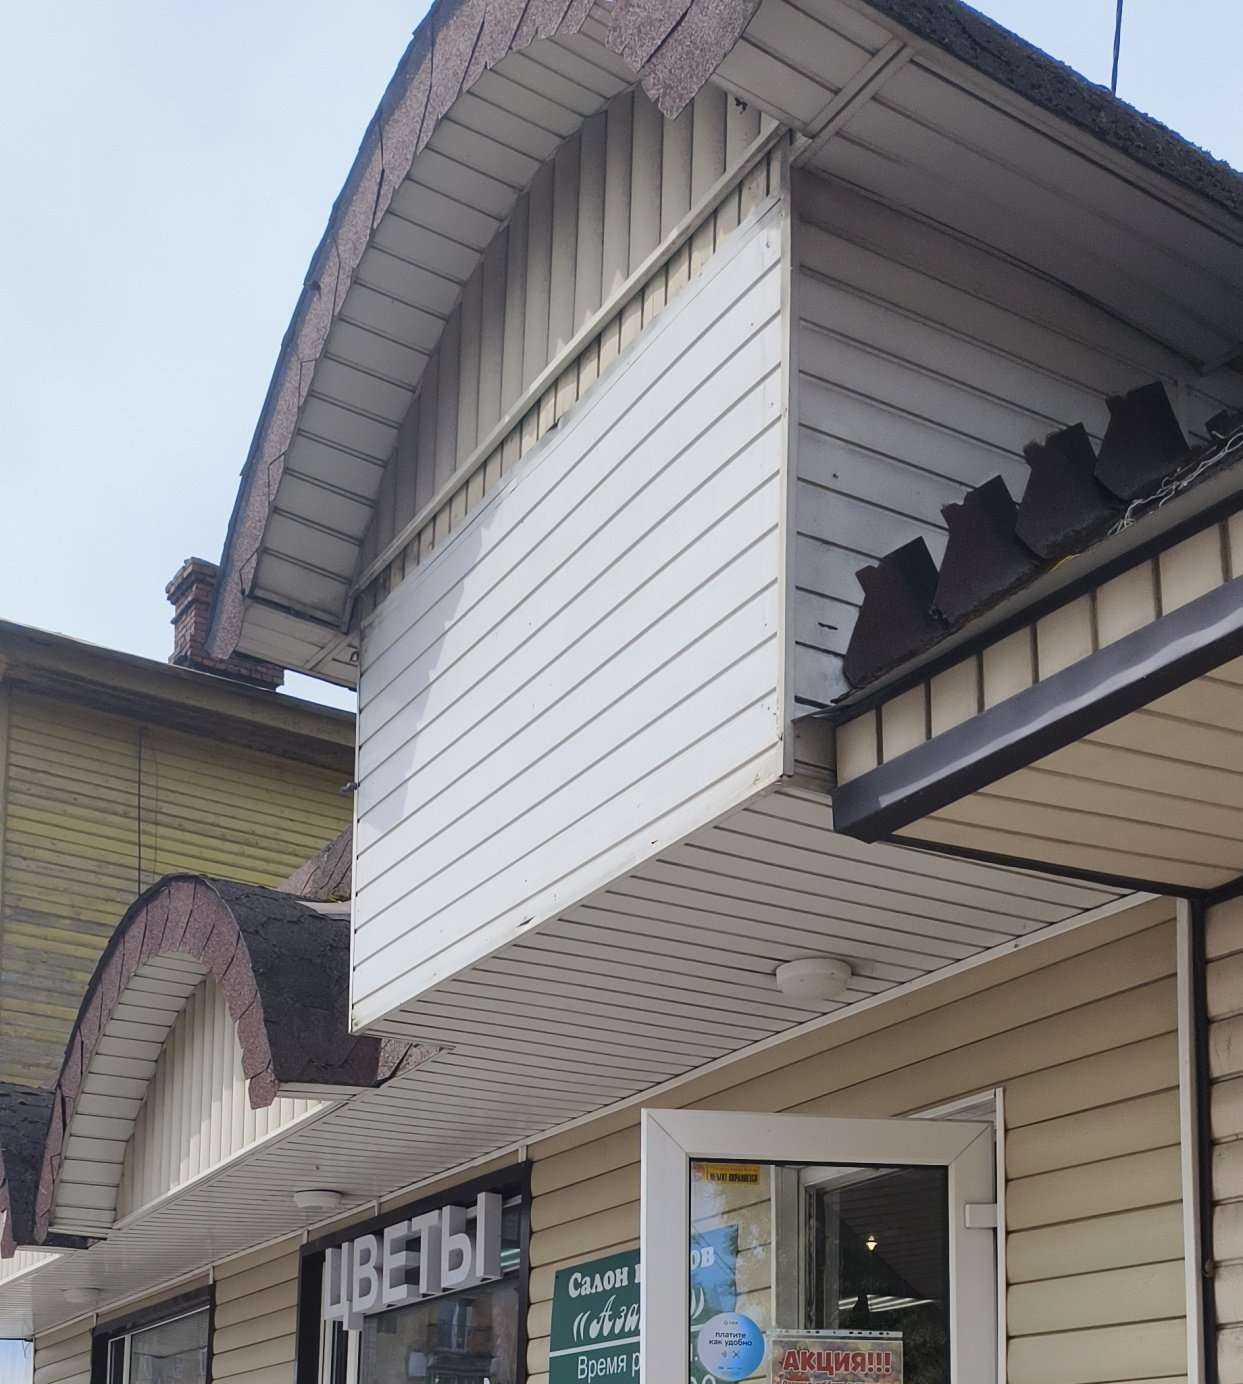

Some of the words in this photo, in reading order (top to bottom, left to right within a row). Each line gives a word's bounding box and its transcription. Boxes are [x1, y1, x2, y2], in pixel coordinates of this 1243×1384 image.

[324, 1192, 502, 1330] ЦВЕТЫ
[568, 1266, 629, 1298] Салон
[715, 1331, 747, 1339] платите
[724, 1338, 753, 1347] удобно
[577, 1352, 627, 1384] Время
[782, 1350, 892, 1376] АКЦИЯ!!!
